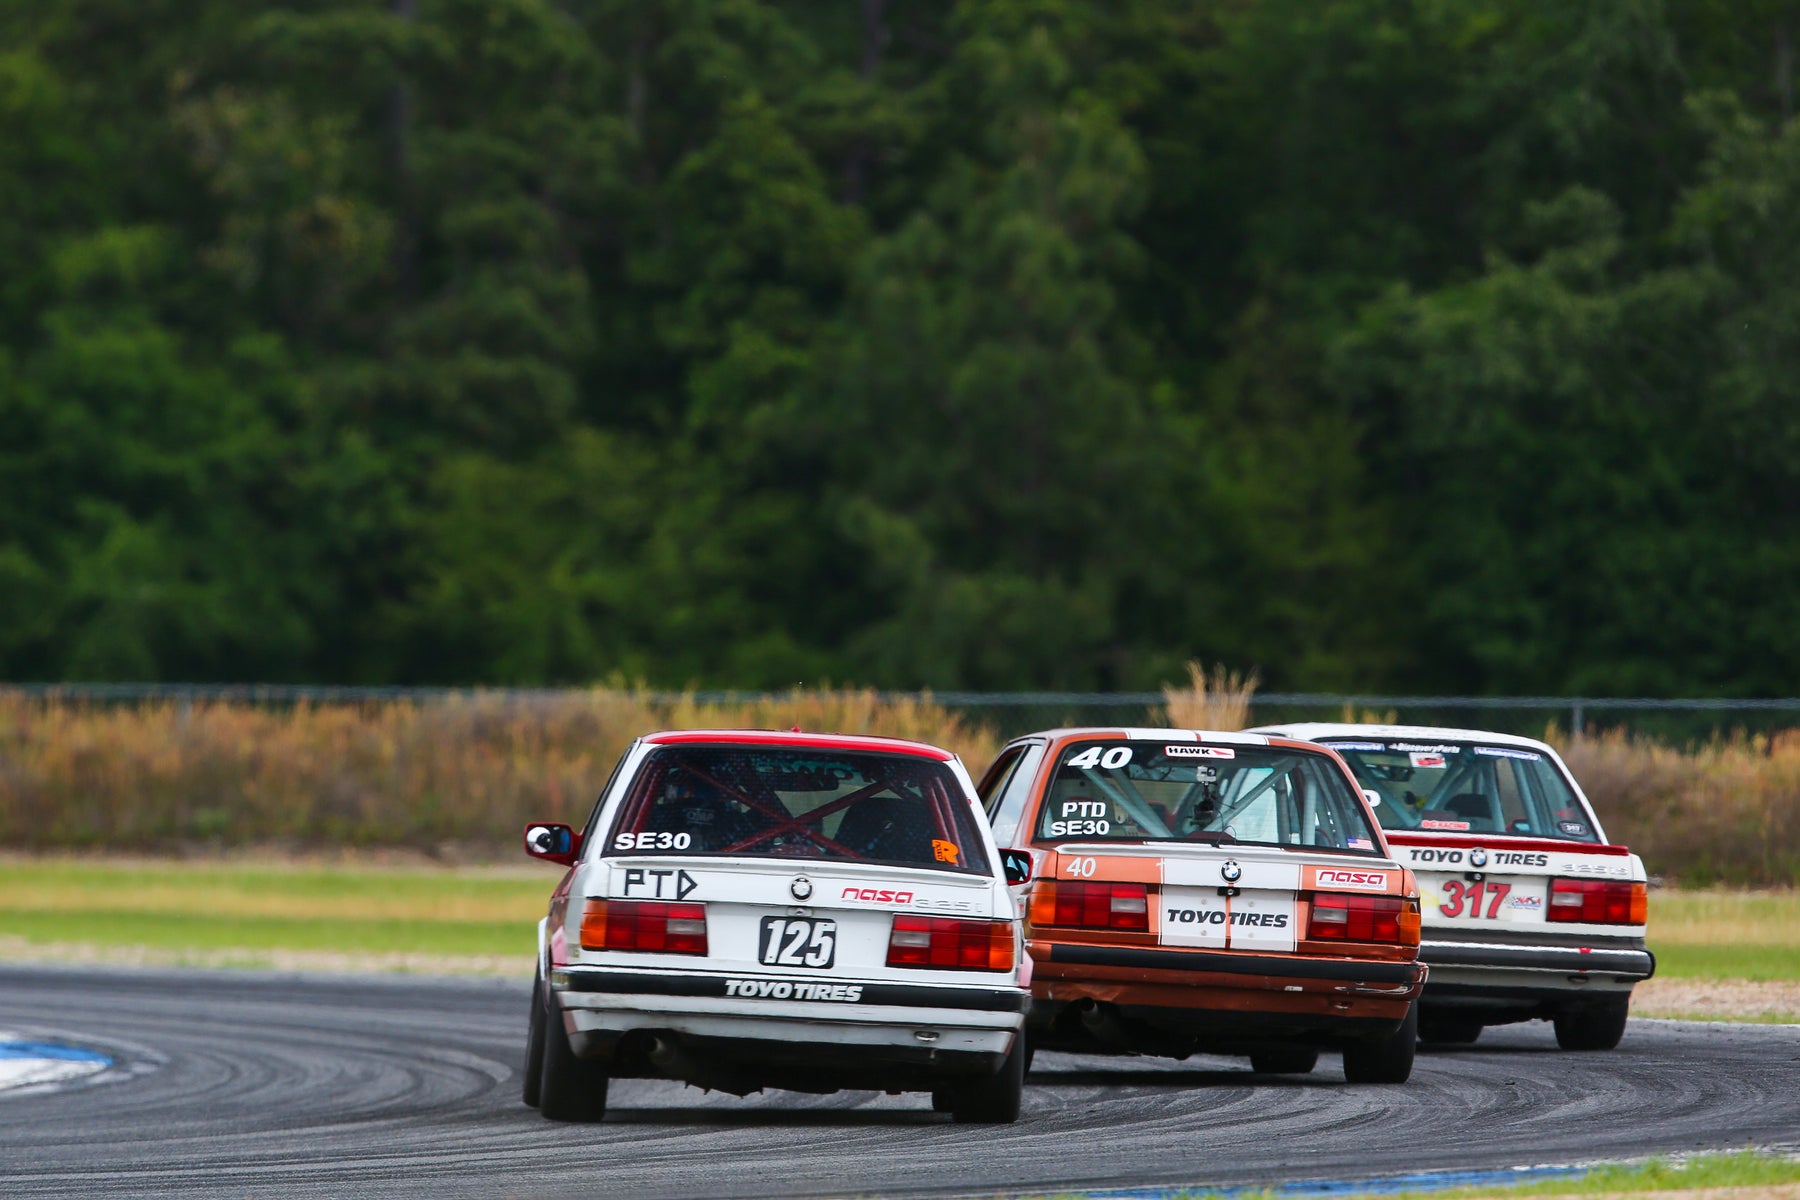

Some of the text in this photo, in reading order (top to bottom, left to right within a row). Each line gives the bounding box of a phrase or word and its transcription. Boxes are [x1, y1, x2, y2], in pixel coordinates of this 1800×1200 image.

[1067, 746, 1133, 770] 40
[1168, 747, 1210, 756] HAWK
[1062, 801, 1107, 818] PTD
[1051, 820, 1110, 836] SE30
[614, 832, 691, 850] SE30
[1410, 849, 1548, 867] TOYO TIRES
[1066, 857, 1097, 878] 40
[1440, 880, 1512, 919] 317
[764, 919, 836, 967] 125
